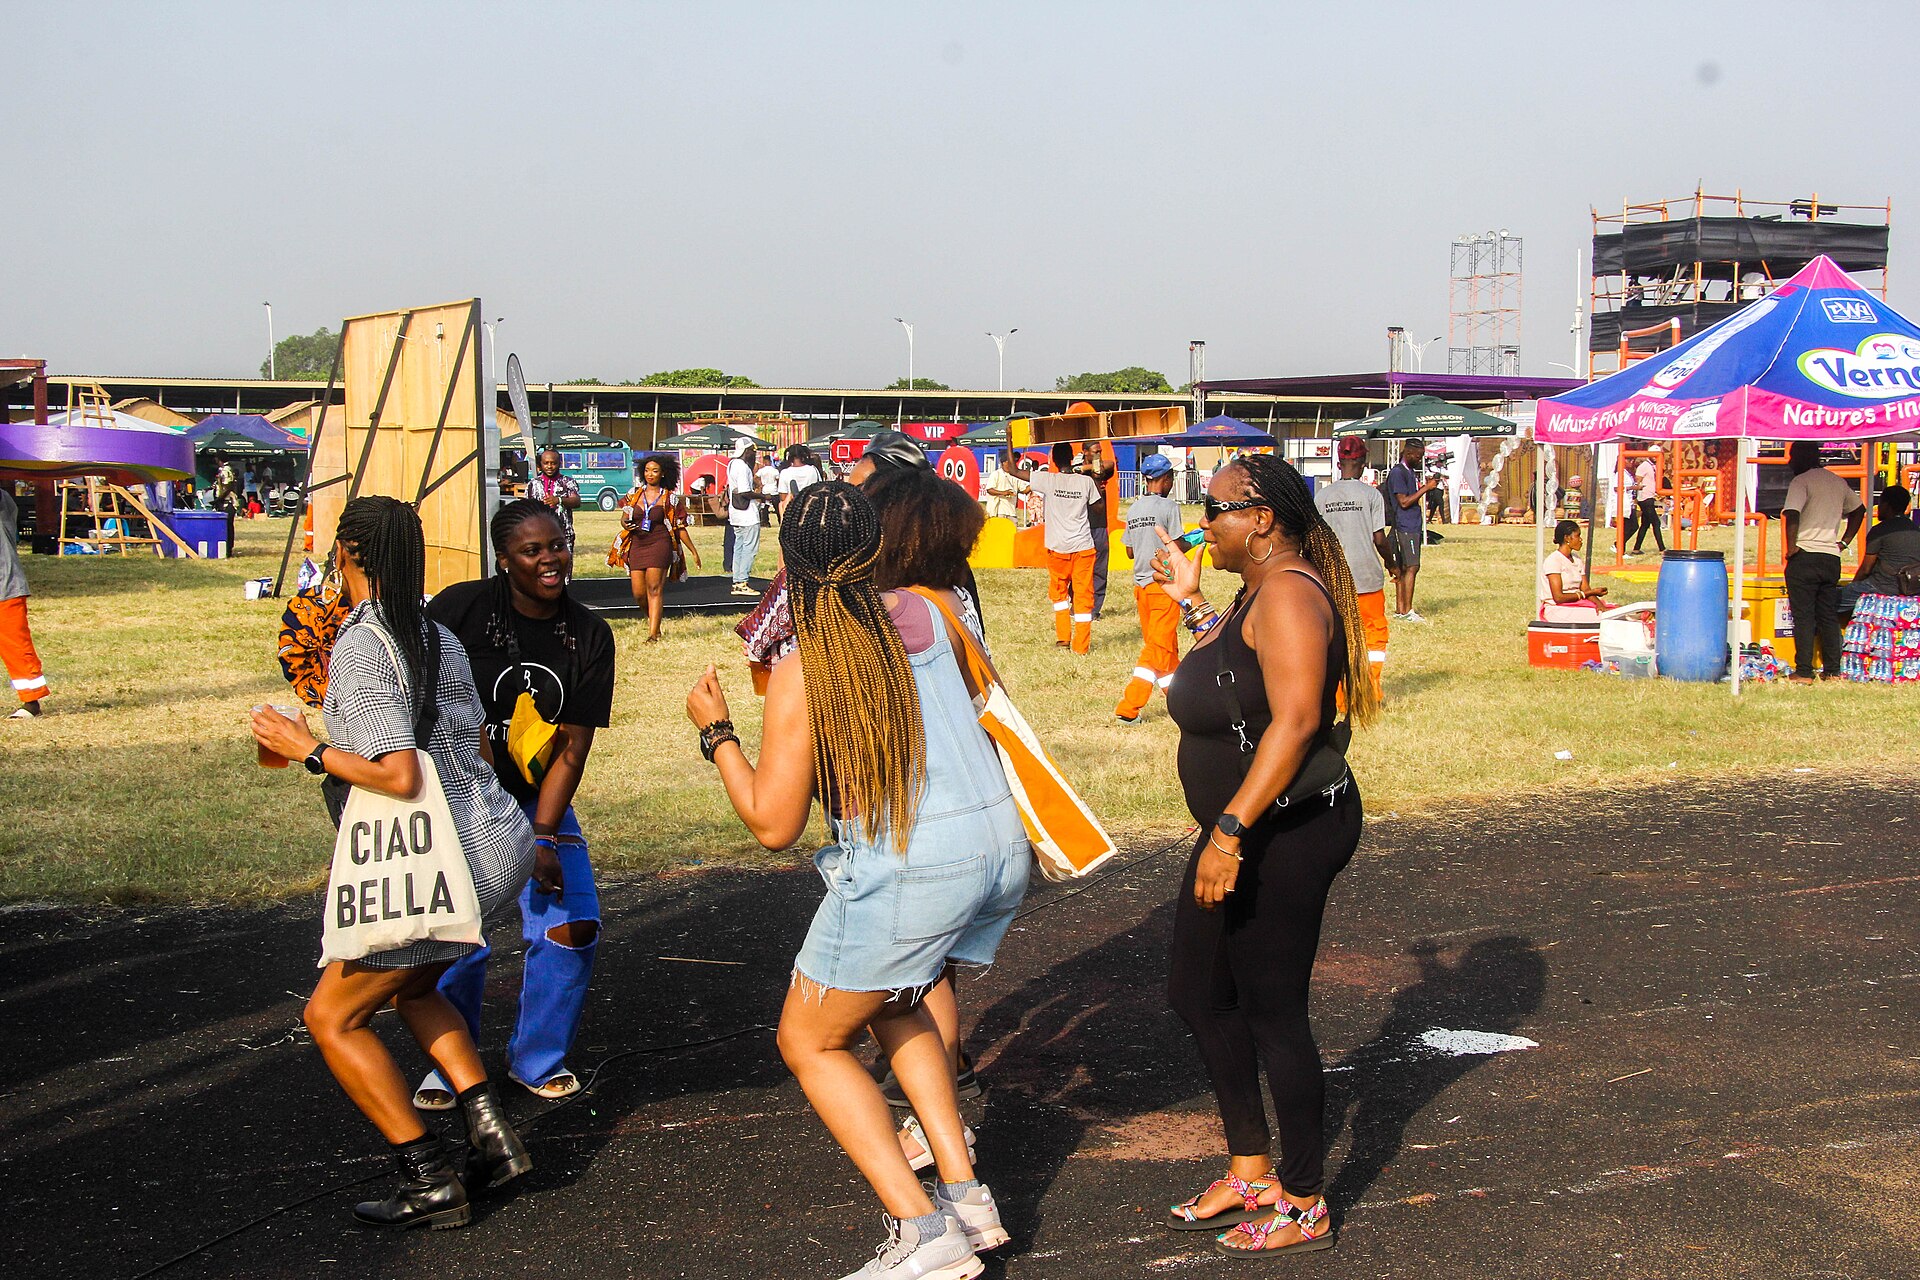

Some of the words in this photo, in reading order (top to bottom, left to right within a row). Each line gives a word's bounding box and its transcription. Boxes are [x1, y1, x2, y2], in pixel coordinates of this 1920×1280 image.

[1636, 400, 1686, 417] MINERAL
[1783, 403, 1876, 426] Nature's
[924, 426, 945, 438] VIP
[1637, 415, 1668, 431] WATER
[350, 810, 433, 866] CIAO
[336, 870, 456, 929] BELLA
